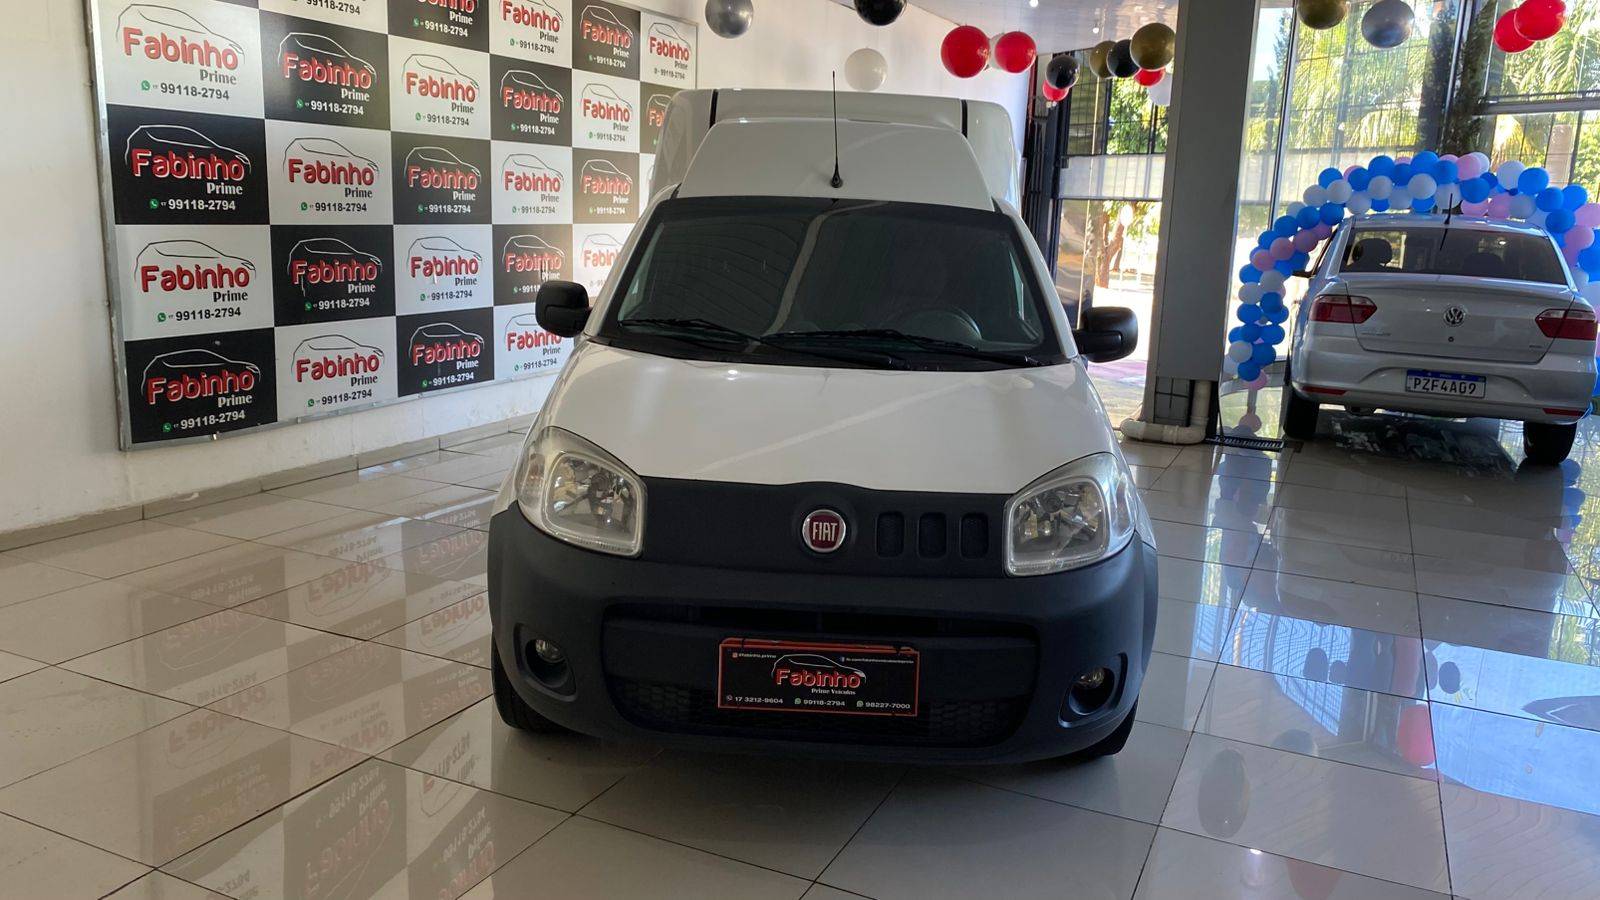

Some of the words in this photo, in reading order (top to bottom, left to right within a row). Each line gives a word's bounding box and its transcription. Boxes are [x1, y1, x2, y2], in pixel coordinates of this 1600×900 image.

[449, 11, 473, 25] Prime
[501, 0, 561, 33] Fabinho
[424, 20, 468, 37] 99118-2794
[580, 19, 631, 49] Fabinho
[539, 31, 559, 43] Prime
[122, 27, 239, 71] Fabinho
[519, 41, 555, 54] 99118-2794
[649, 36, 690, 62] Fabinho
[199, 69, 237, 85] Prime
[282, 53, 373, 89] Fabinho
[160, 82, 229, 100] 99118-2794
[340, 87, 370, 102] Prime
[405, 72, 477, 103] Fabinho
[310, 100, 364, 115] 99118-2794
[451, 102, 474, 114] Prime
[503, 87, 561, 114] Fabinho
[582, 98, 631, 122] Fabinho
[426, 113, 470, 127] 99118-2794
[539, 113, 560, 125] Prime
[519, 123, 555, 135] 99118-2794
[130, 148, 245, 181] Fabinho
[288, 159, 375, 186] Fabinho
[407, 166, 478, 190] Fabinho
[504, 170, 561, 193] Fabinho
[580, 175, 631, 195] Fabinho
[206, 182, 243, 195] Prime
[344, 187, 373, 199] Prime
[452, 190, 476, 201] Prime
[168, 199, 236, 211] 99118-2794
[315, 202, 367, 213] 99118-2794
[428, 203, 471, 214] 99118-2794
[505, 252, 562, 273] Fabinho
[583, 249, 618, 268] Fabin
[291, 259, 378, 285] Fabinho
[410, 256, 479, 278] Fabinho
[140, 264, 251, 293] Fabinho
[454, 277, 477, 287] Prime
[347, 283, 377, 294] Prime
[430, 290, 473, 301] 99118-2794
[212, 291, 249, 303] Prime
[318, 297, 370, 310] 99118-2794
[175, 307, 241, 321] 99118-2794
[412, 339, 481, 366] Fabinho
[295, 353, 380, 383] Fabinho
[456, 359, 480, 370] Prime
[523, 358, 557, 370] 99118-2794
[146, 369, 255, 405] Fabinho
[350, 374, 378, 387] Prime
[432, 372, 475, 387] 99118-2794
[1413, 377, 1477, 395] PZF4A09
[217, 394, 253, 408] Prime
[321, 389, 373, 405] 99118-2794
[180, 410, 246, 430] 99118-2794
[812, 521, 838, 542] FIAT
[774, 668, 861, 689] Fabinho
